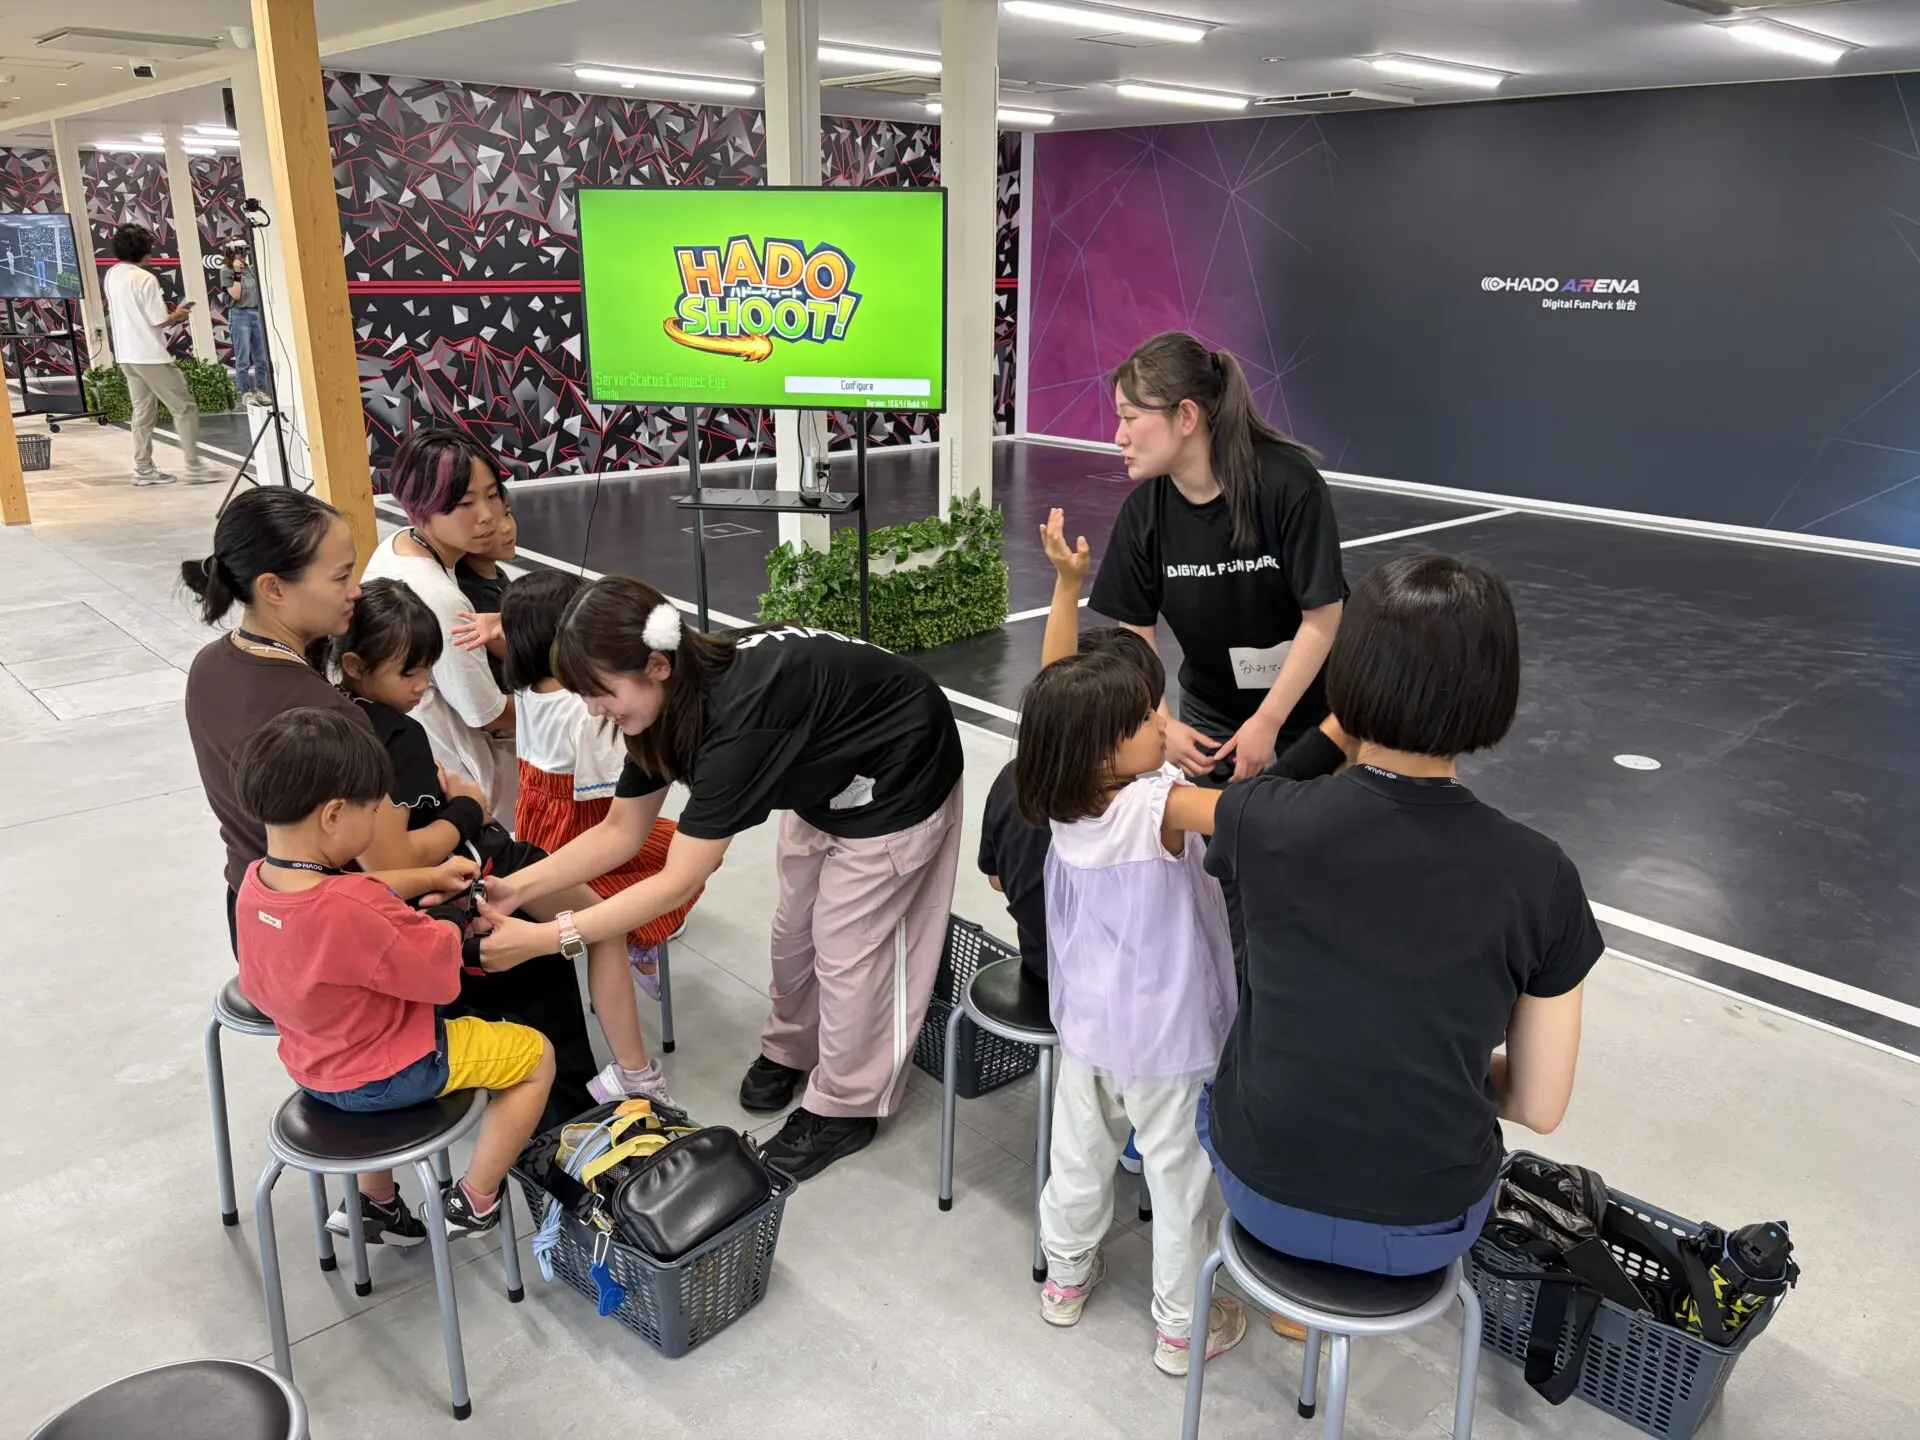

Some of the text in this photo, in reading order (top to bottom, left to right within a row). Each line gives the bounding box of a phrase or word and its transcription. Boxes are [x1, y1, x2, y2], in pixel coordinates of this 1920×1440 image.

[677, 239, 848, 300] HADO
[1505, 277, 1640, 294] HADO ARENA
[1542, 298, 1637, 311] Digital Fun Park 仙台
[679, 294, 857, 340] SHOOT!
[840, 379, 874, 392] Configure
[597, 387, 619, 400] Ready
[1167, 564, 1216, 578] DIGITAL
